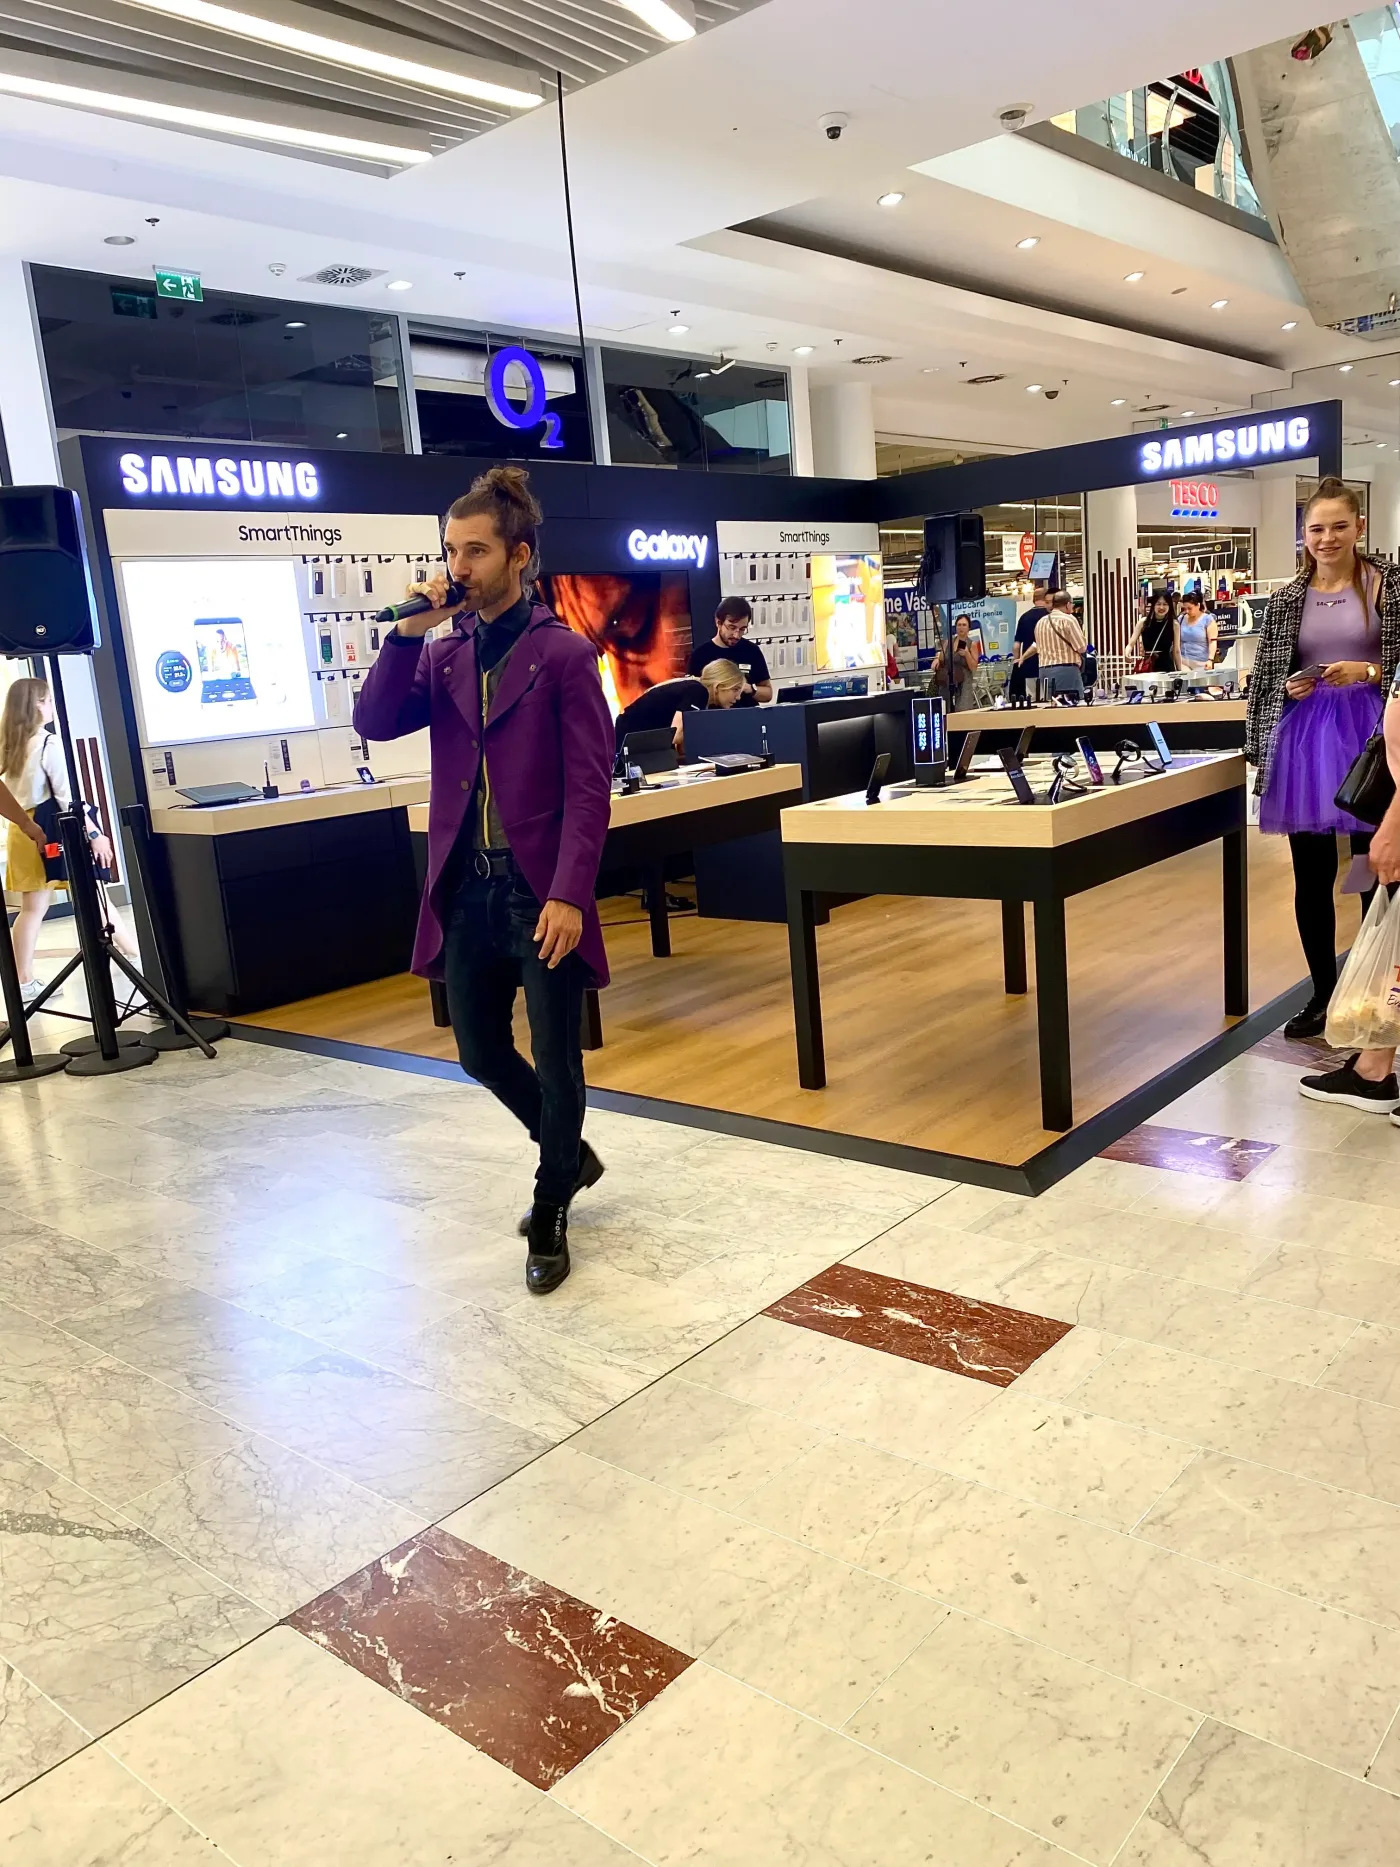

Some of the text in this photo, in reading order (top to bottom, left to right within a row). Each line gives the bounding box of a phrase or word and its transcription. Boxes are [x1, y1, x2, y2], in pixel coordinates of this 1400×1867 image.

[1142, 416, 1310, 471] SAMSUNG
[119, 452, 320, 498] SAMSUNG
[1169, 479, 1219, 508] TESCO
[238, 524, 342, 546] SmartThings
[628, 528, 708, 568] Galaxy
[779, 530, 830, 546] SmartThings
